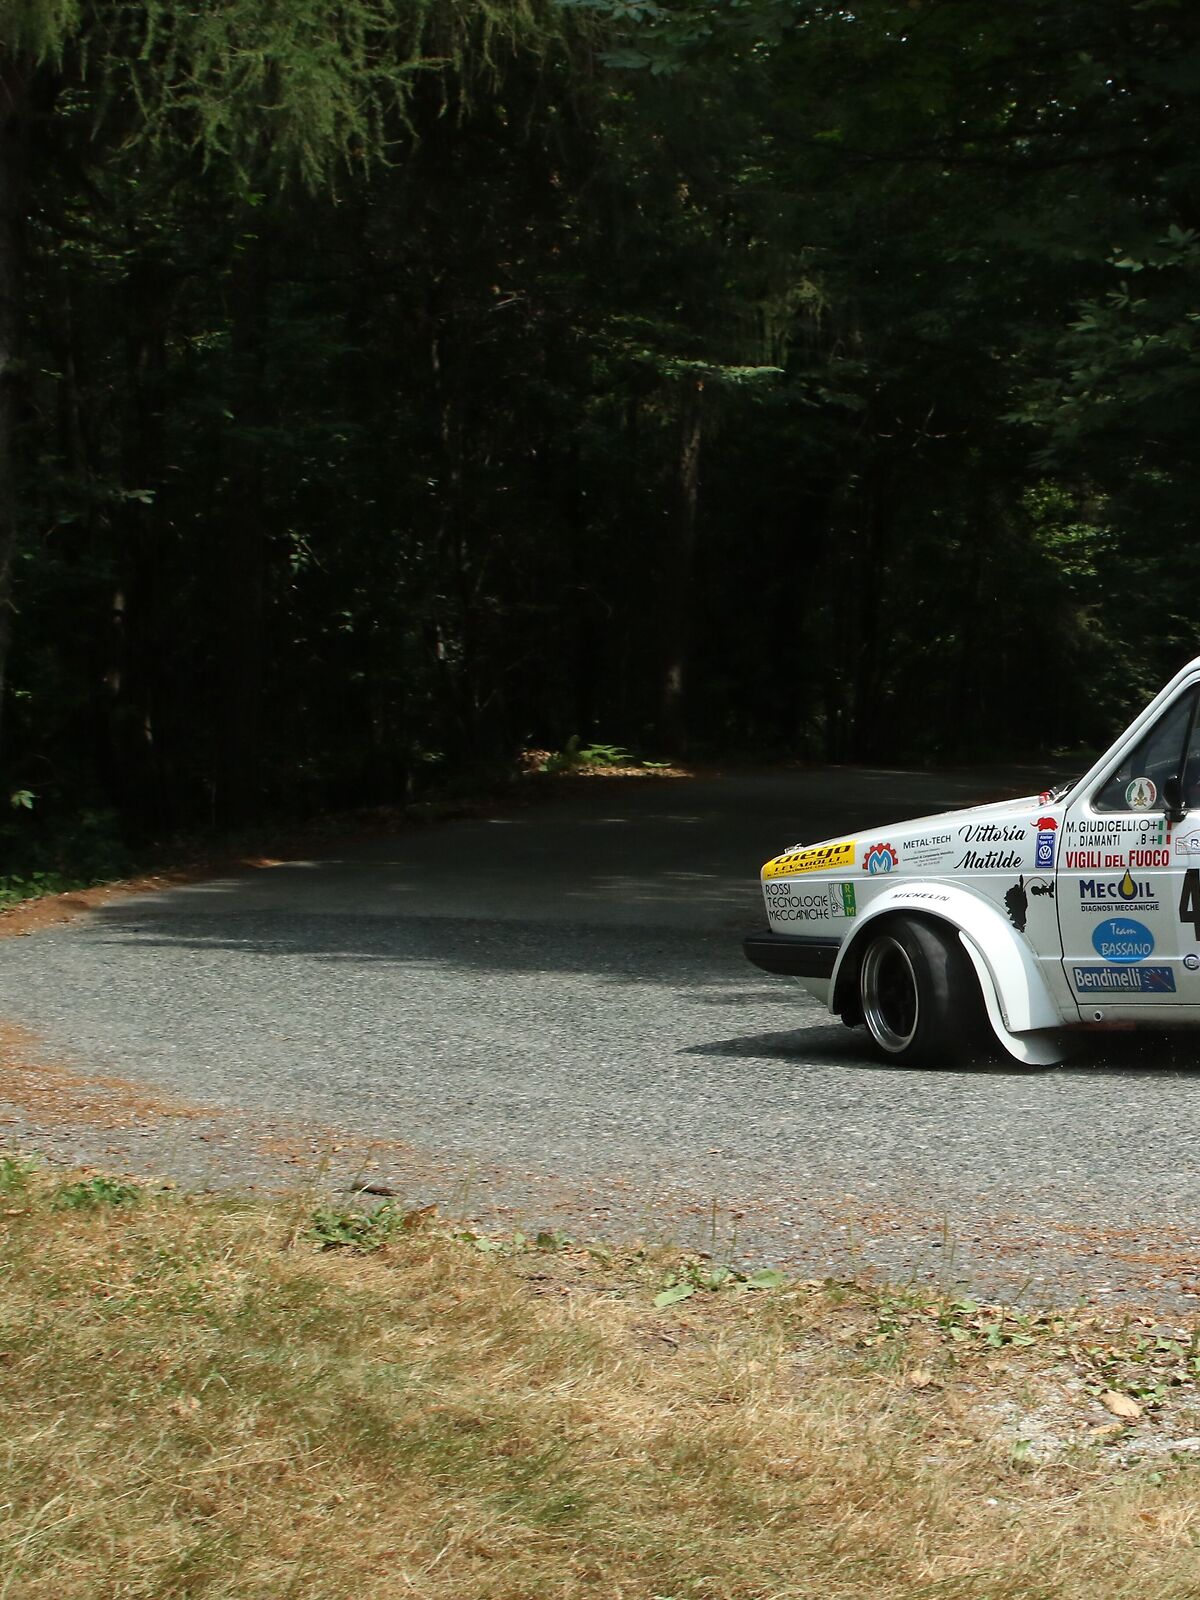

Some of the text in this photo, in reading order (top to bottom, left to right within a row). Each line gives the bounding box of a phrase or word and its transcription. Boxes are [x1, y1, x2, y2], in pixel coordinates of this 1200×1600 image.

[958, 824, 1028, 843] Vittoria
[903, 835, 952, 850] METAL-TECH
[1079, 834, 1120, 847] DIAMANTI
[953, 850, 1024, 869] Matilde
[1065, 850, 1170, 868] VIGILI DEL FUOCO
[765, 883, 790, 895] ROSSI
[767, 895, 829, 908] TECNOLOGIE
[891, 892, 951, 901] MICHELIN
[769, 908, 829, 921] MECCANICHE
[1081, 904, 1113, 912] DIAGNOSI
[1110, 922, 1136, 935] Team
[1101, 943, 1151, 956] BASSANO
[1074, 968, 1142, 987] Bendinelli
